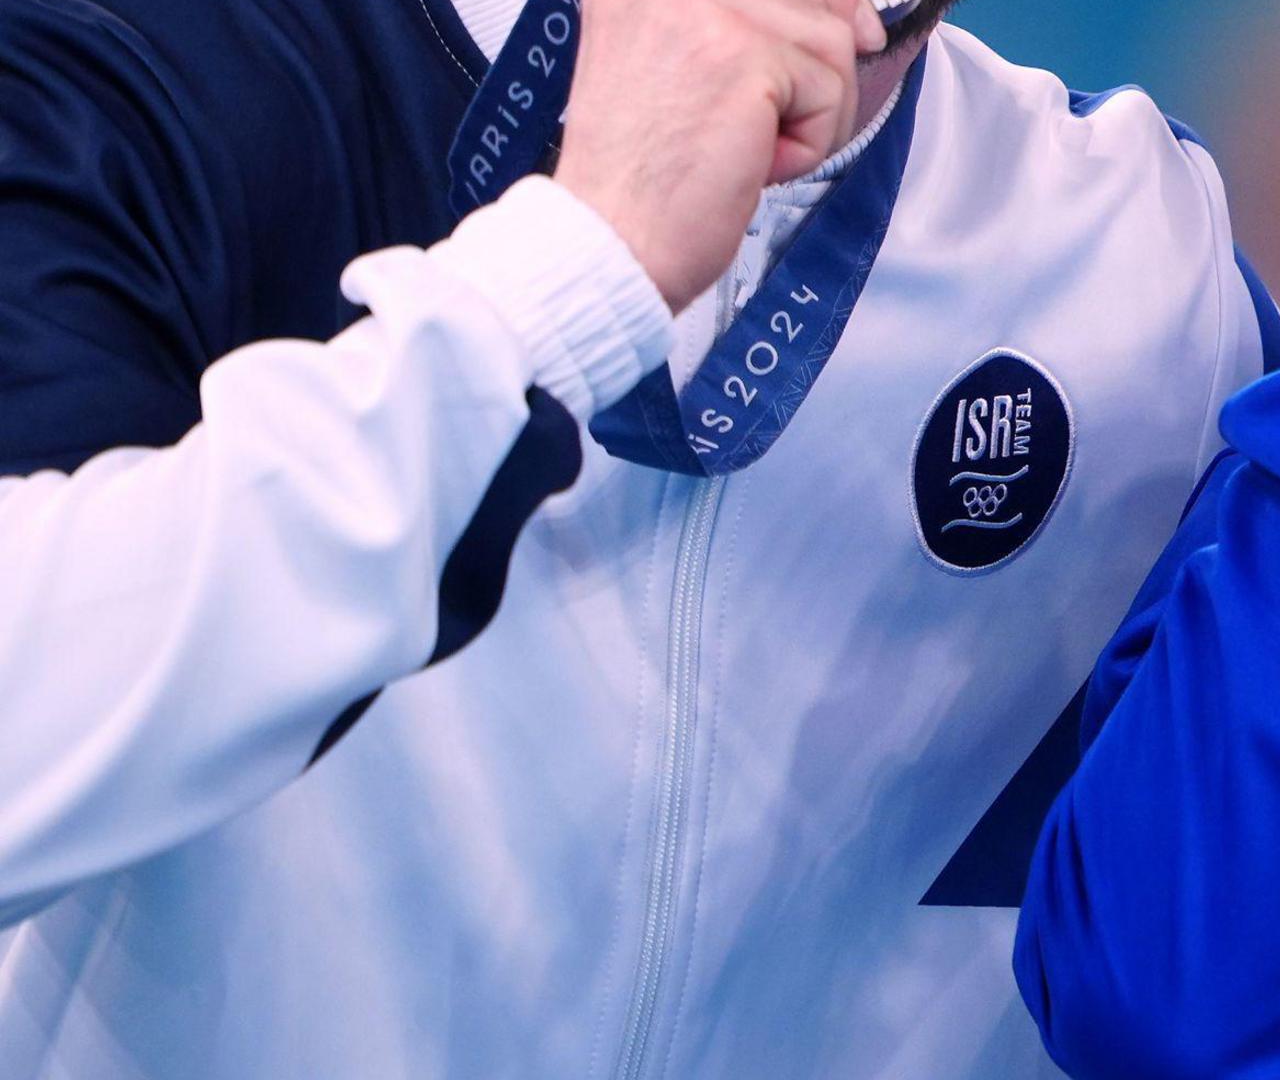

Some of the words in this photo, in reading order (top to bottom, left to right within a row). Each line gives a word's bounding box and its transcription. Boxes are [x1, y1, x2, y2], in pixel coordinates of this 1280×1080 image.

[723, 284, 820, 408] 2024
[951, 394, 1014, 463] ISR
[1013, 387, 1032, 457] TEAM
